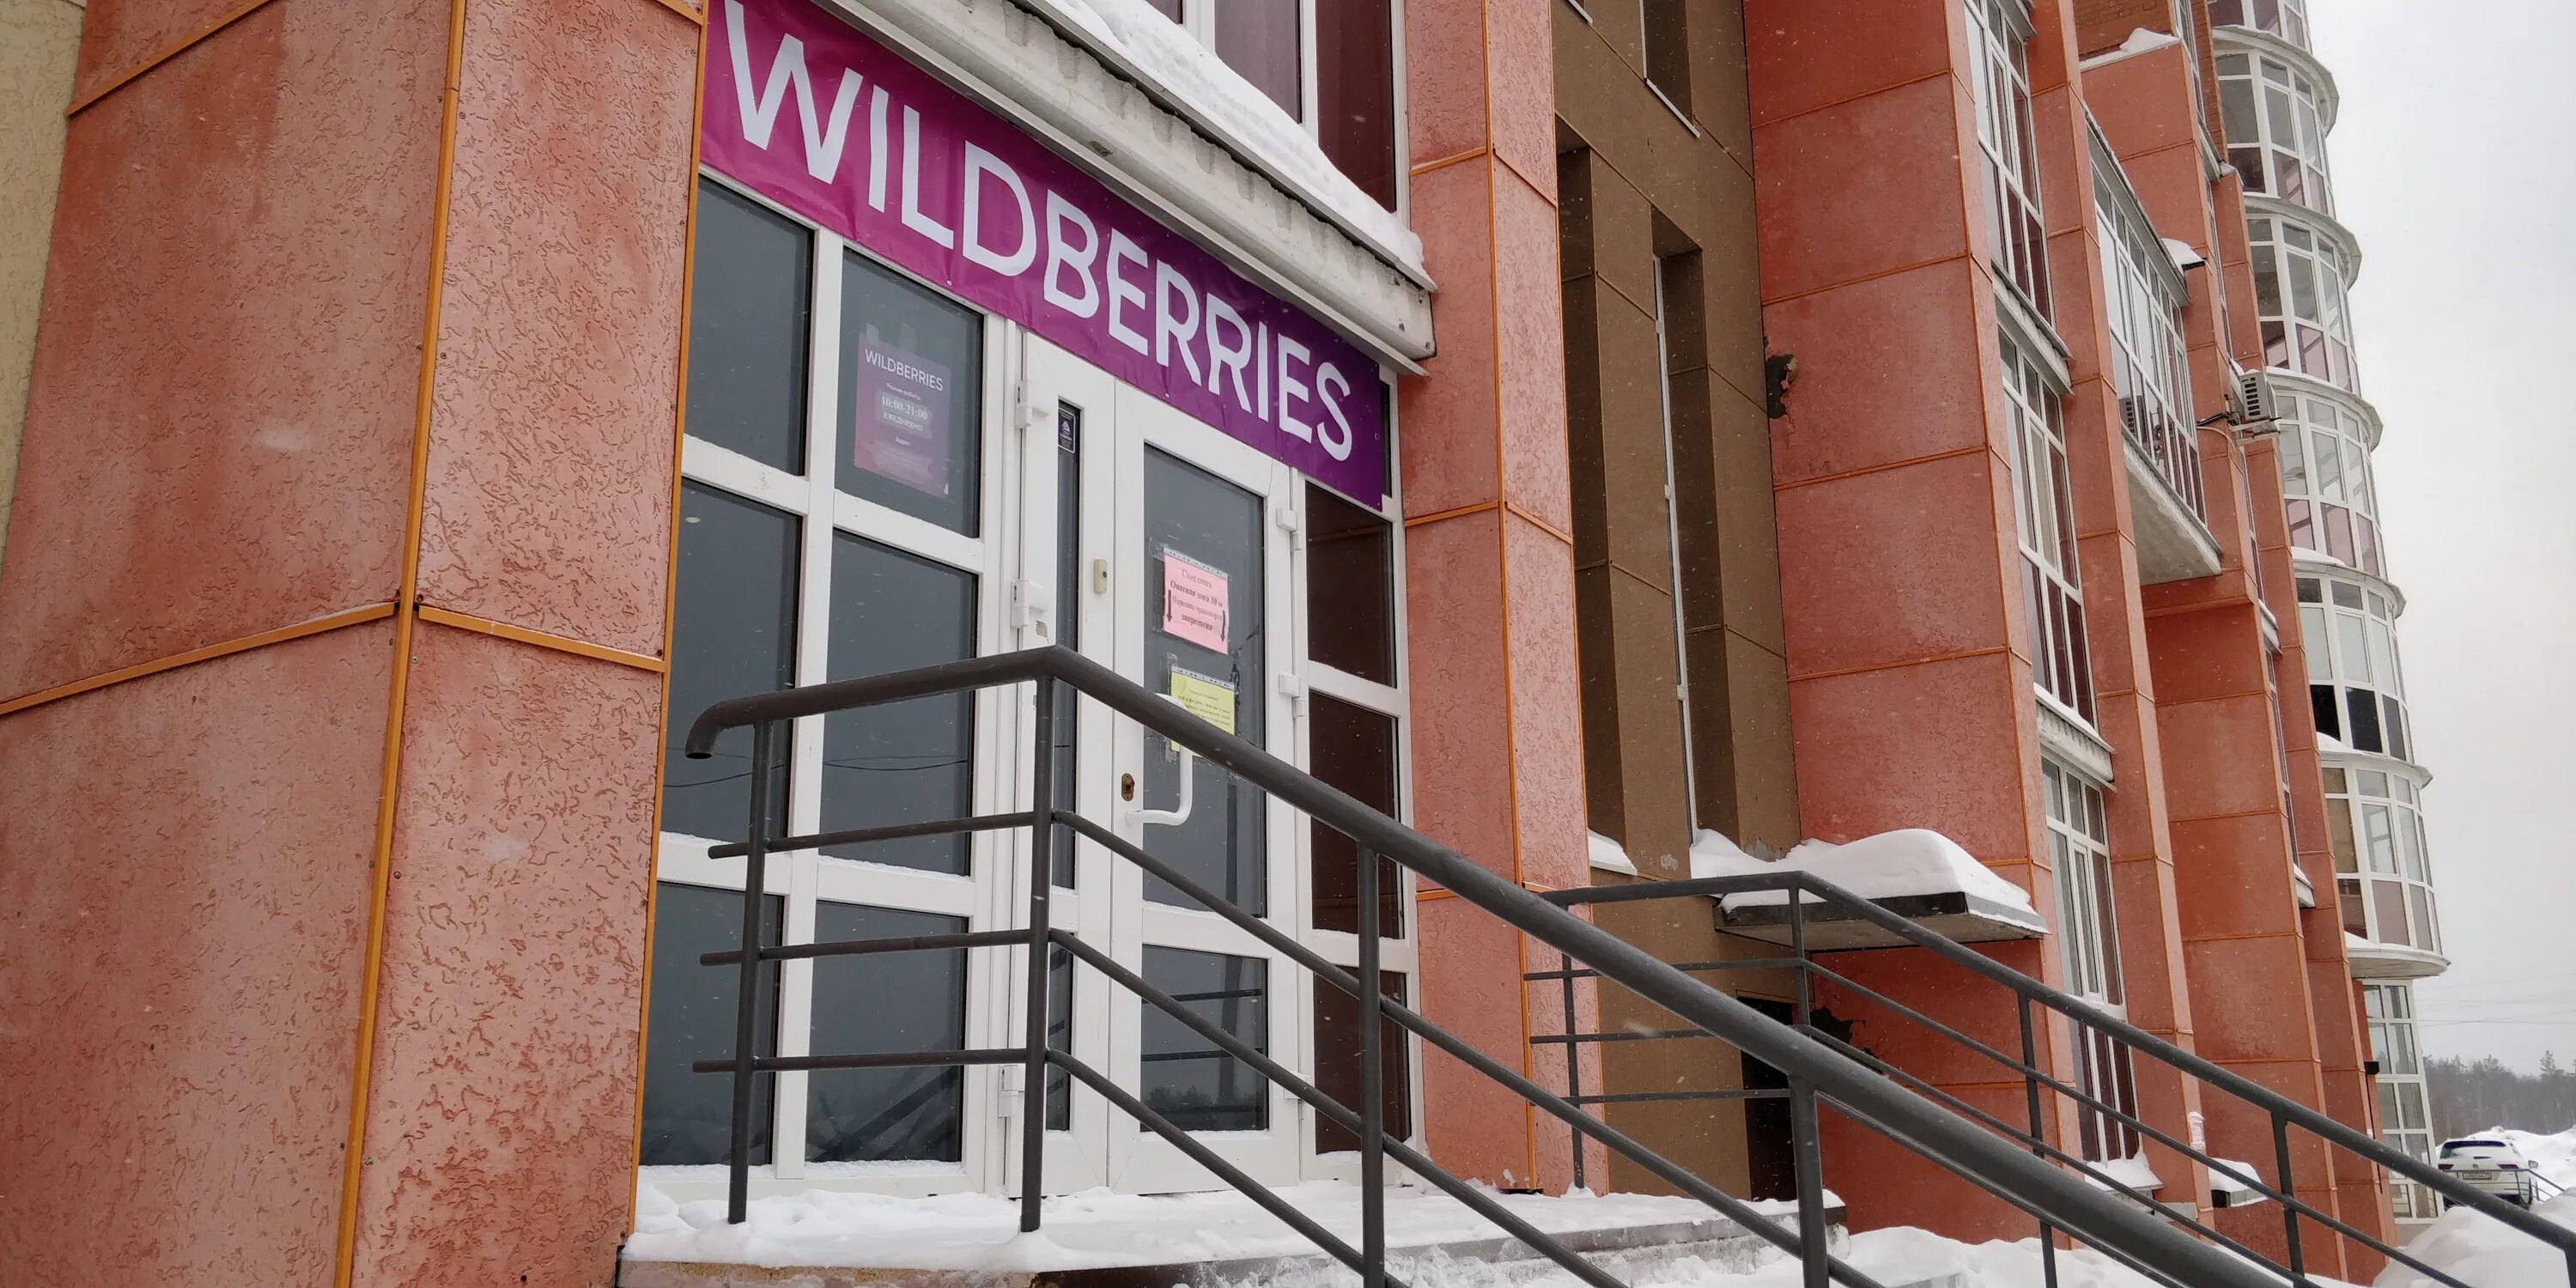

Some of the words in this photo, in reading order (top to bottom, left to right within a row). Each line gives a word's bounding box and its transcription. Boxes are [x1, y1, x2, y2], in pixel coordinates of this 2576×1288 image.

[725, 0, 1354, 462] WILDBERRIES
[865, 348, 944, 392] WILDBERRIES
[1170, 580, 1196, 597] Опасная
[1182, 569, 1197, 584] Сход
